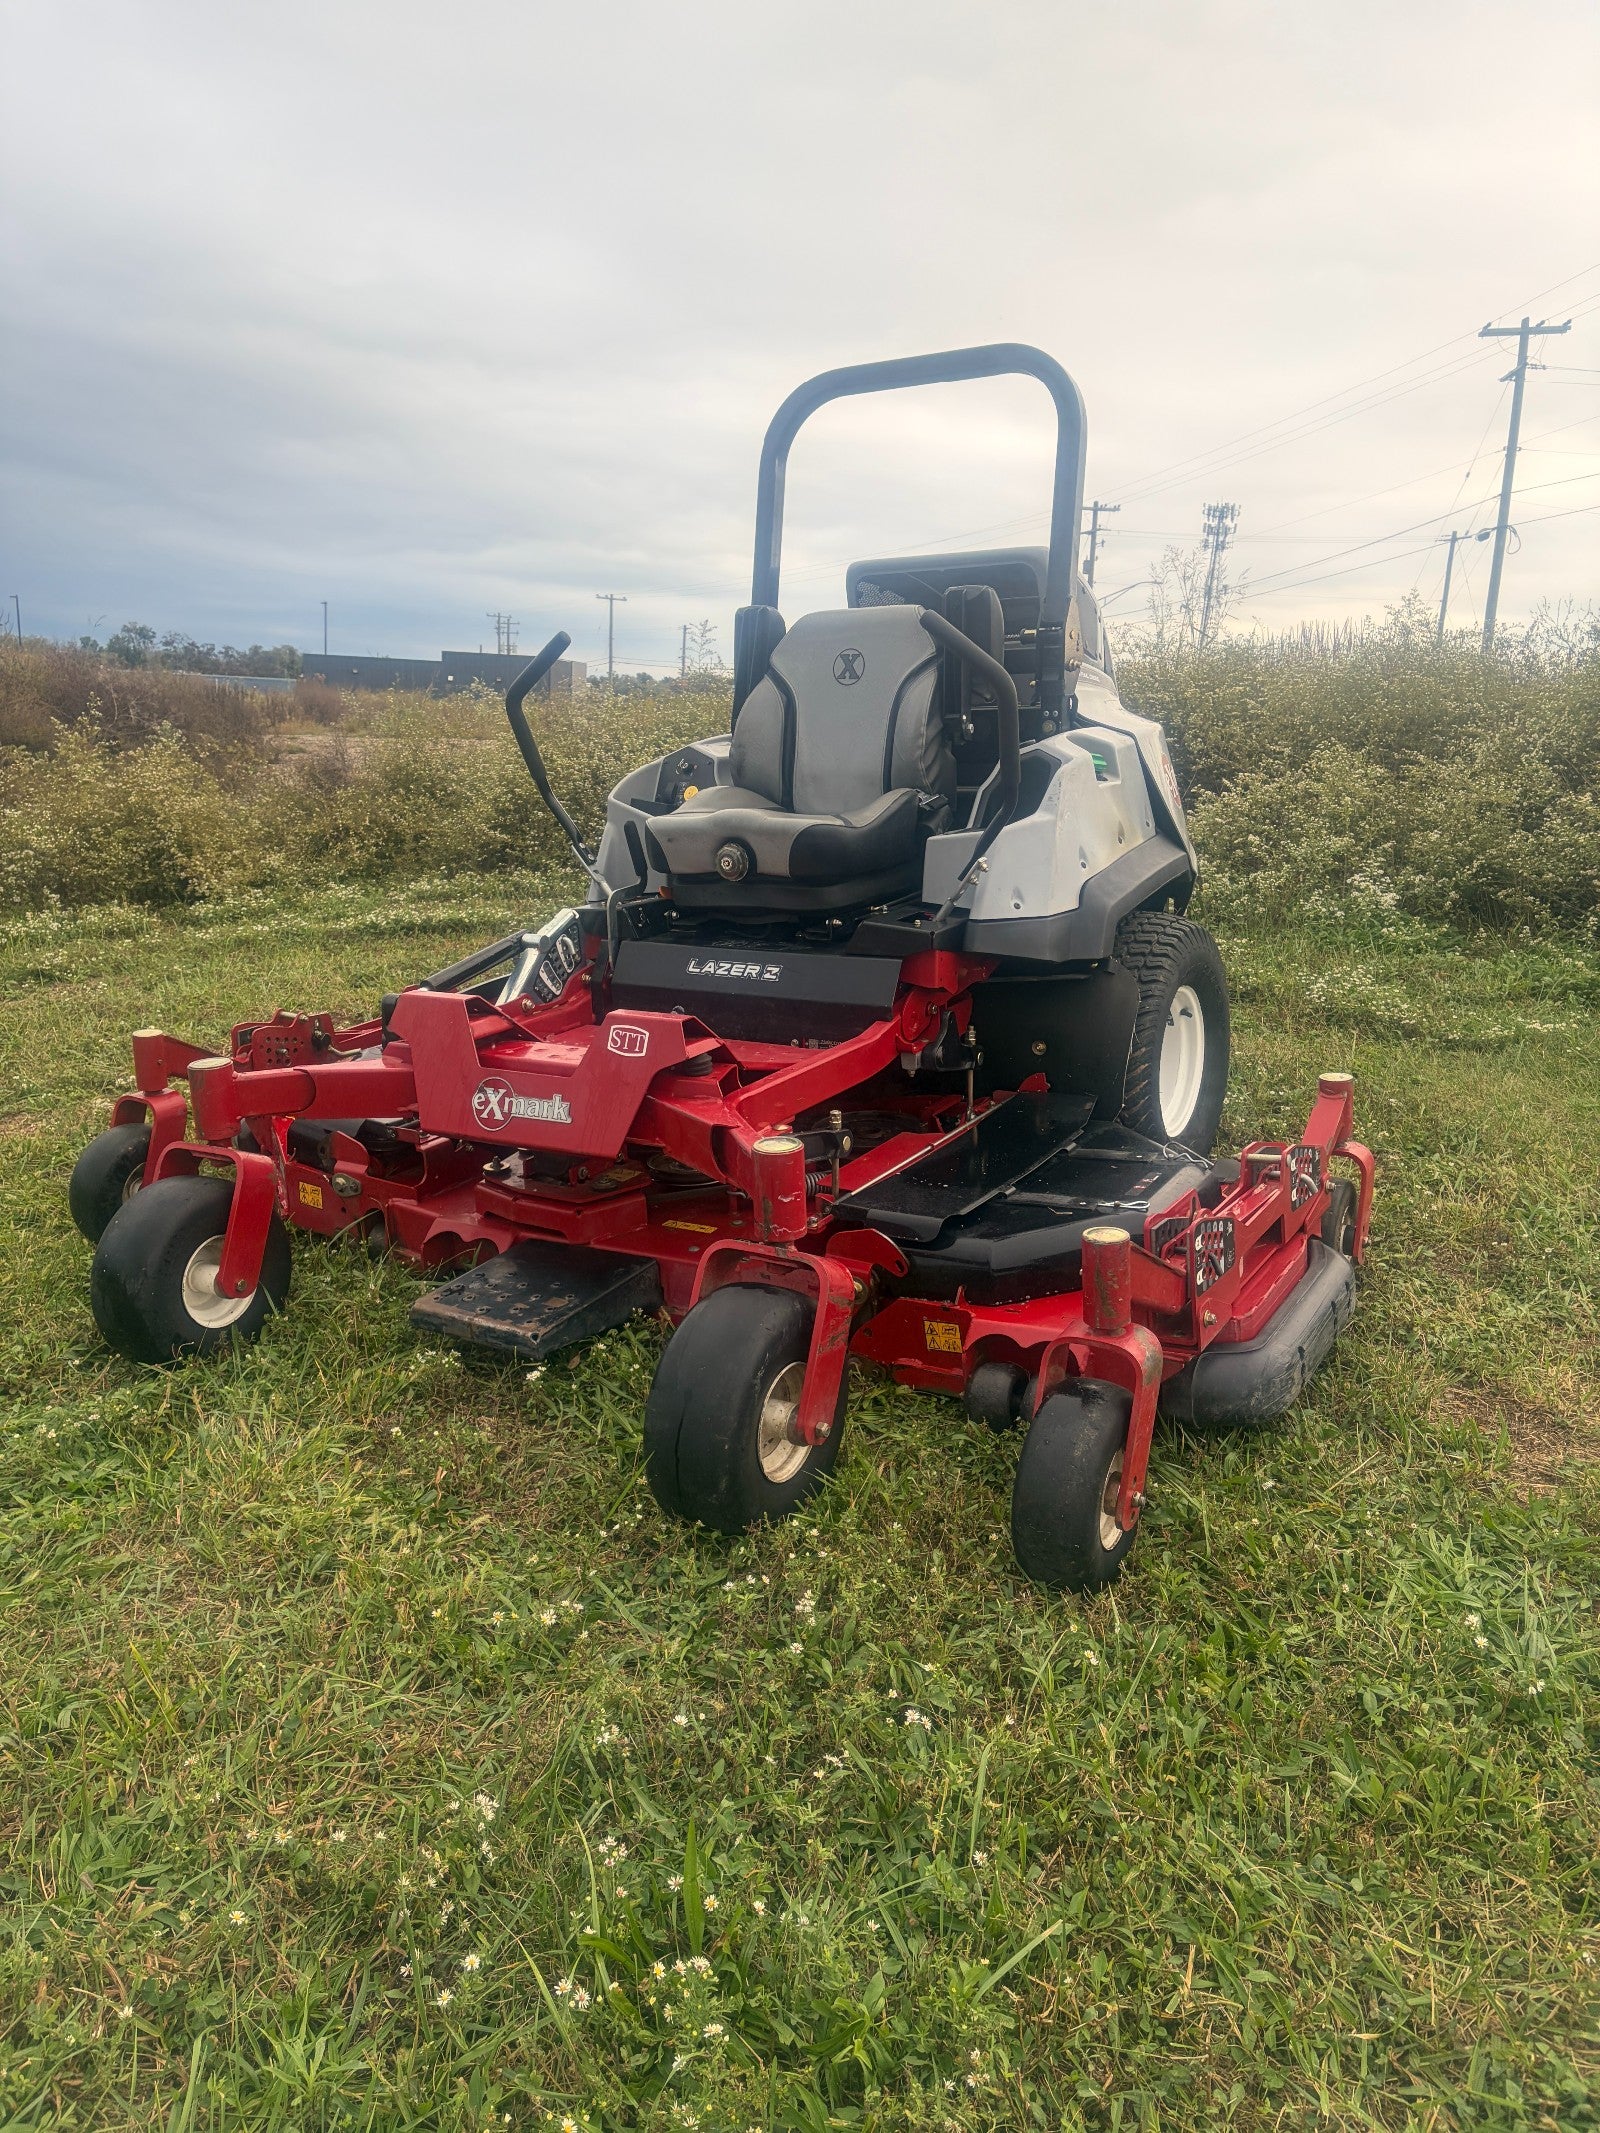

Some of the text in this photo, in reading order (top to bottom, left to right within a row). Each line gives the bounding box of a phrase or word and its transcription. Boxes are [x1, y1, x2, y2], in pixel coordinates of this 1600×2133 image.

[836, 653, 861, 680] X
[687, 958, 782, 981] LAZER Z
[610, 1029, 646, 1052] STT
